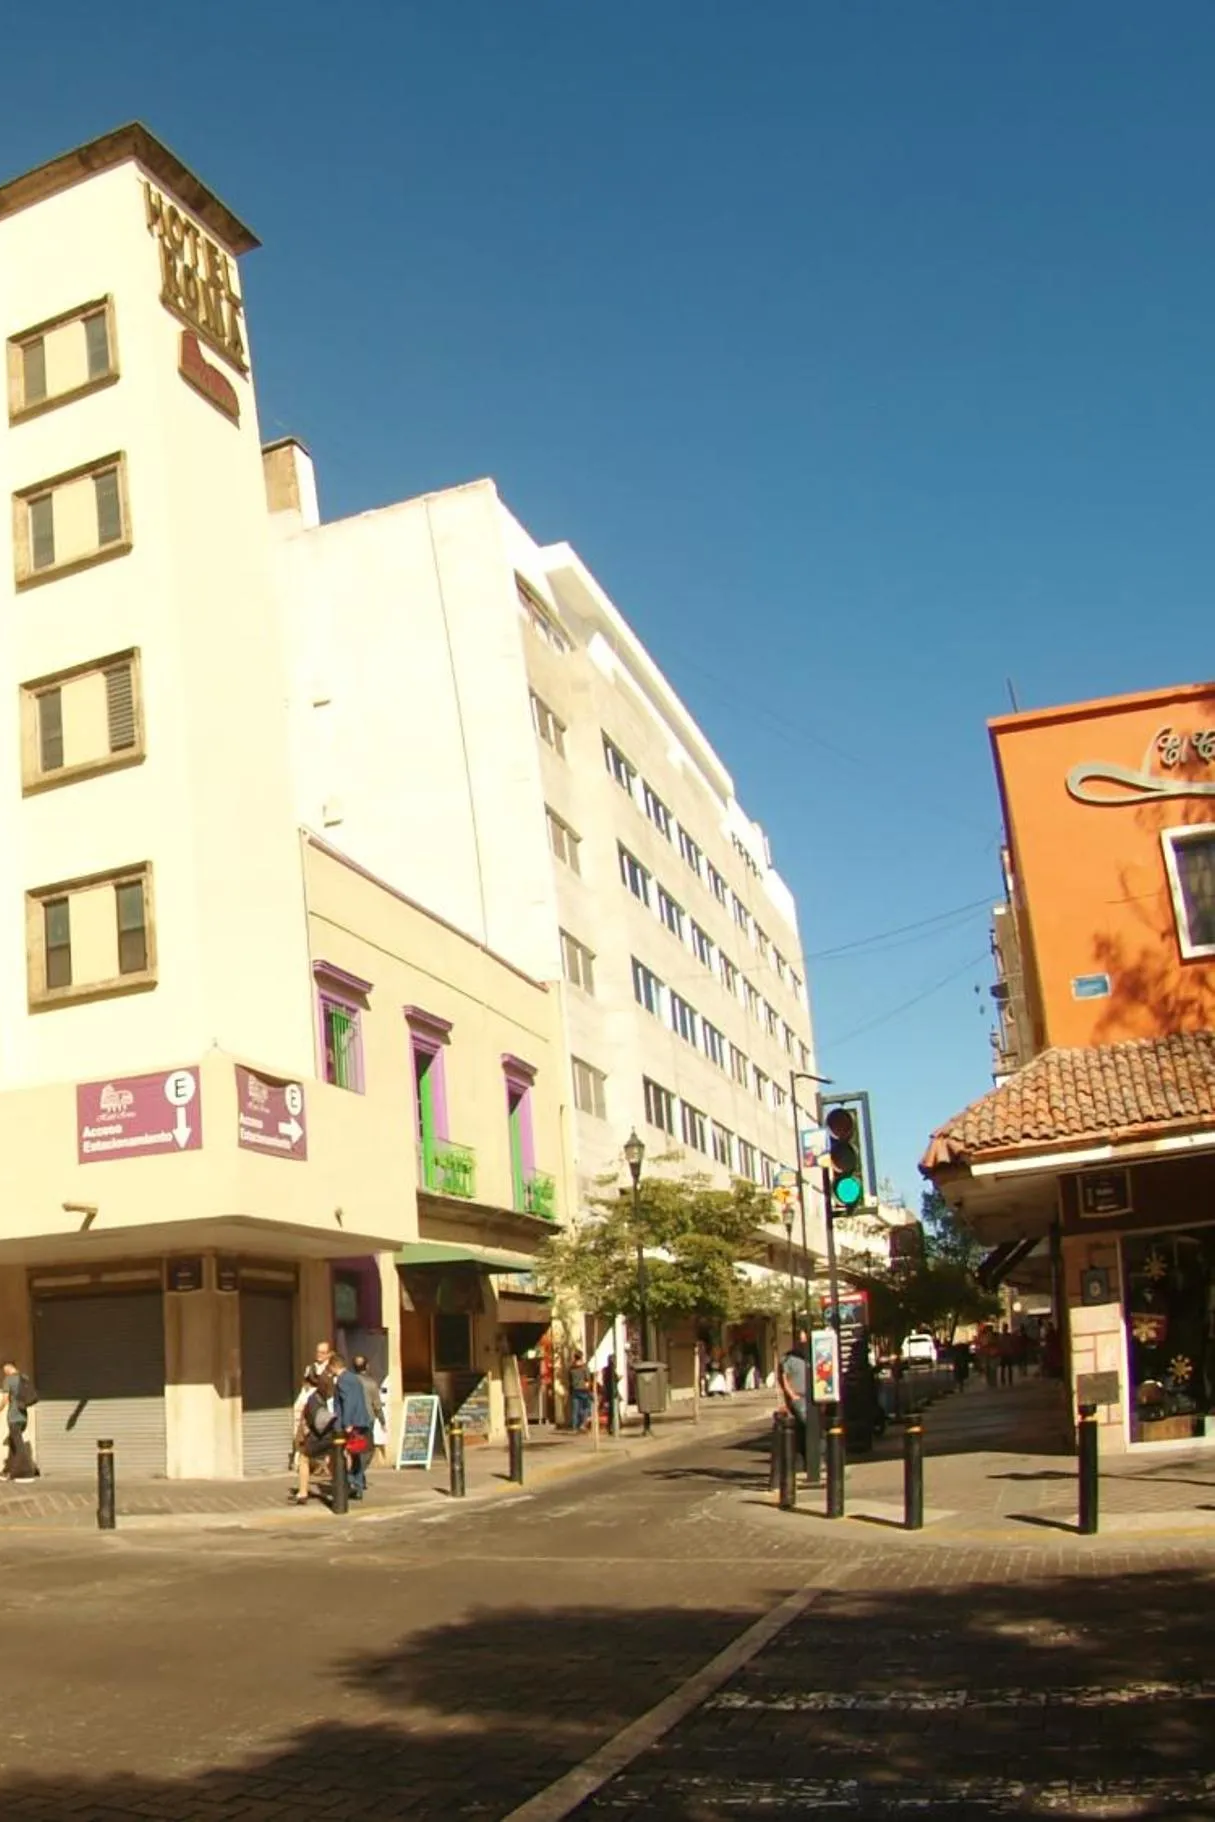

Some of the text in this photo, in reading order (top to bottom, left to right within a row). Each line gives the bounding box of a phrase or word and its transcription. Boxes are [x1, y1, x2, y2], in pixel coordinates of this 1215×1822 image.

[143, 180, 243, 309] HOTEL
[174, 1078, 187, 1098] E
[291, 1089, 299, 1109] E
